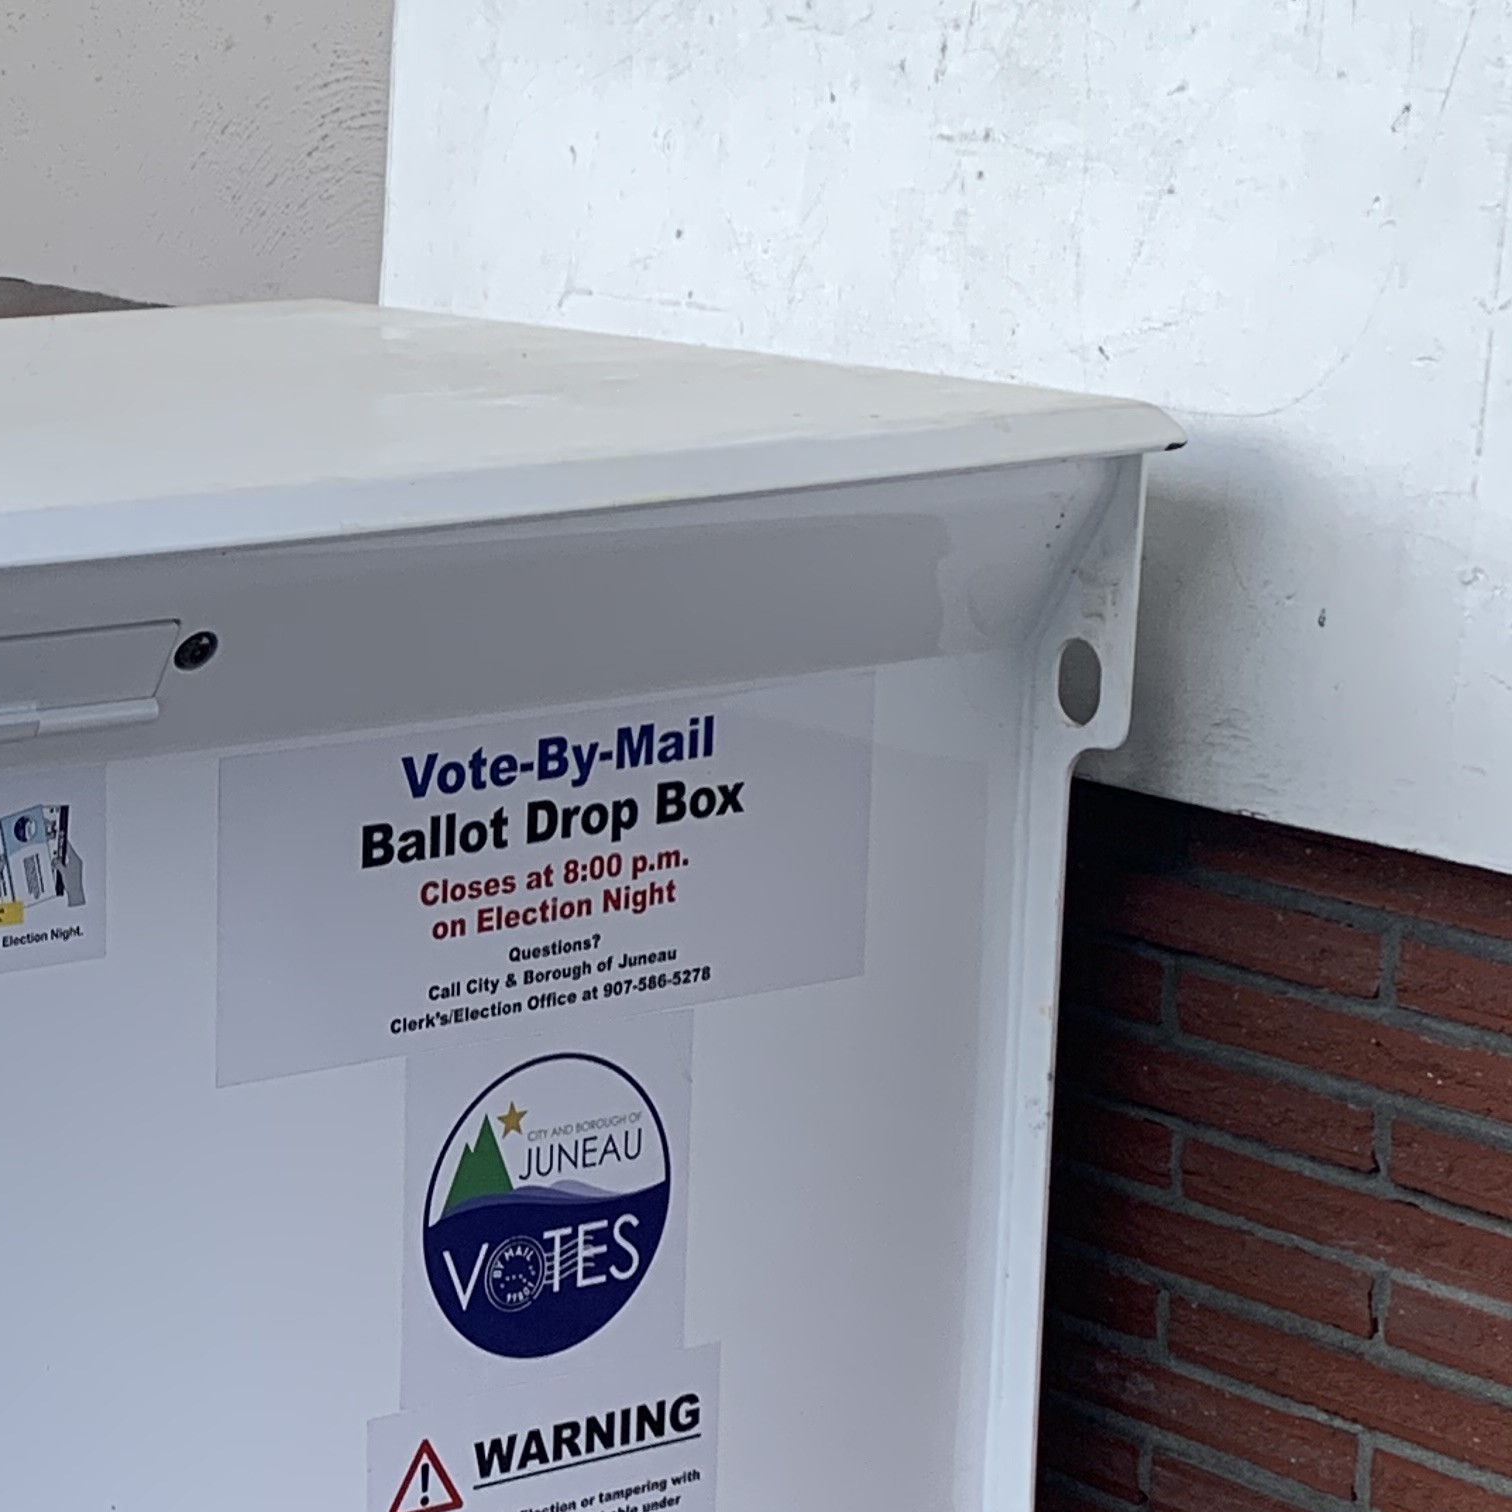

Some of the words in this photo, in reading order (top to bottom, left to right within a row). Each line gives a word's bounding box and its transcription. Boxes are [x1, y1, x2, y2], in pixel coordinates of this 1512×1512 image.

[400, 714, 714, 799] Vote-By-Mail
[360, 805, 508, 869] Ballot
[526, 797, 638, 844] Drop
[655, 779, 745, 825] Box
[419, 874, 516, 906] Closes
[525, 863, 553, 890] at
[563, 851, 622, 884] 8:00
[631, 848, 689, 880] p.m.
[1, 931, 48, 948] Election
[49, 925, 83, 941] Night.
[431, 917, 466, 940] on
[476, 896, 592, 934] Election
[602, 878, 676, 914] Night
[427, 980, 460, 1001] Call
[465, 976, 500, 995] City
[504, 972, 517, 988] &
[522, 959, 592, 985] Borough
[596, 955, 613, 973] of
[617, 948, 677, 969] Juneau
[508, 932, 601, 962] Questions?
[389, 1000, 522, 1034] Clerk's/Election
[526, 991, 577, 1011] Office
[581, 985, 598, 1002] at
[602, 965, 711, 998] 907-586-5278
[517, 1127, 642, 1181] JUNEAU
[526, 1128, 548, 1142] CITY
[550, 1123, 573, 1137] AND
[575, 1113, 626, 1134] BOROUGH
[628, 1110, 642, 1124] OF
[442, 1213, 640, 1312] VOTES
[473, 1392, 701, 1479] WARNING
[579, 1495, 595, 1508] or
[598, 1478, 667, 1504] tampering
[670, 1468, 700, 1486] with
[641, 1494, 681, 1512] under
